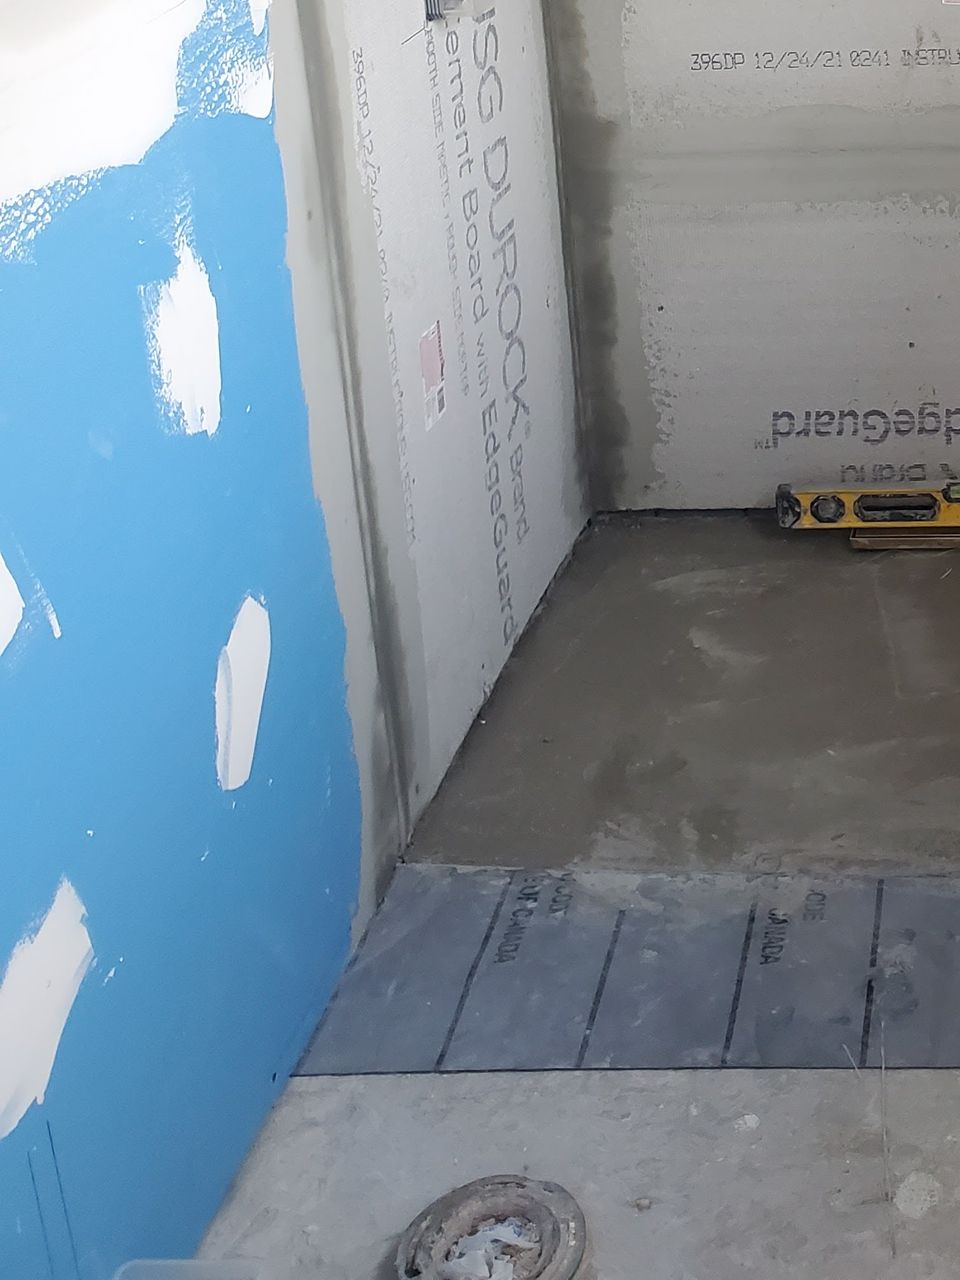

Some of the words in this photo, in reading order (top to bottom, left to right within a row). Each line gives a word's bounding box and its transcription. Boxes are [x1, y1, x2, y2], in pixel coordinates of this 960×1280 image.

[351, 47, 370, 120] 396DP
[690, 52, 745, 70] 396DP
[754, 50, 842, 70] 12/24/21
[431, 92, 445, 139] SIDE
[444, 18, 475, 178] ement
[462, 186, 490, 326] Board
[476, 331, 489, 399] with
[510, 443, 530, 545] Brand
